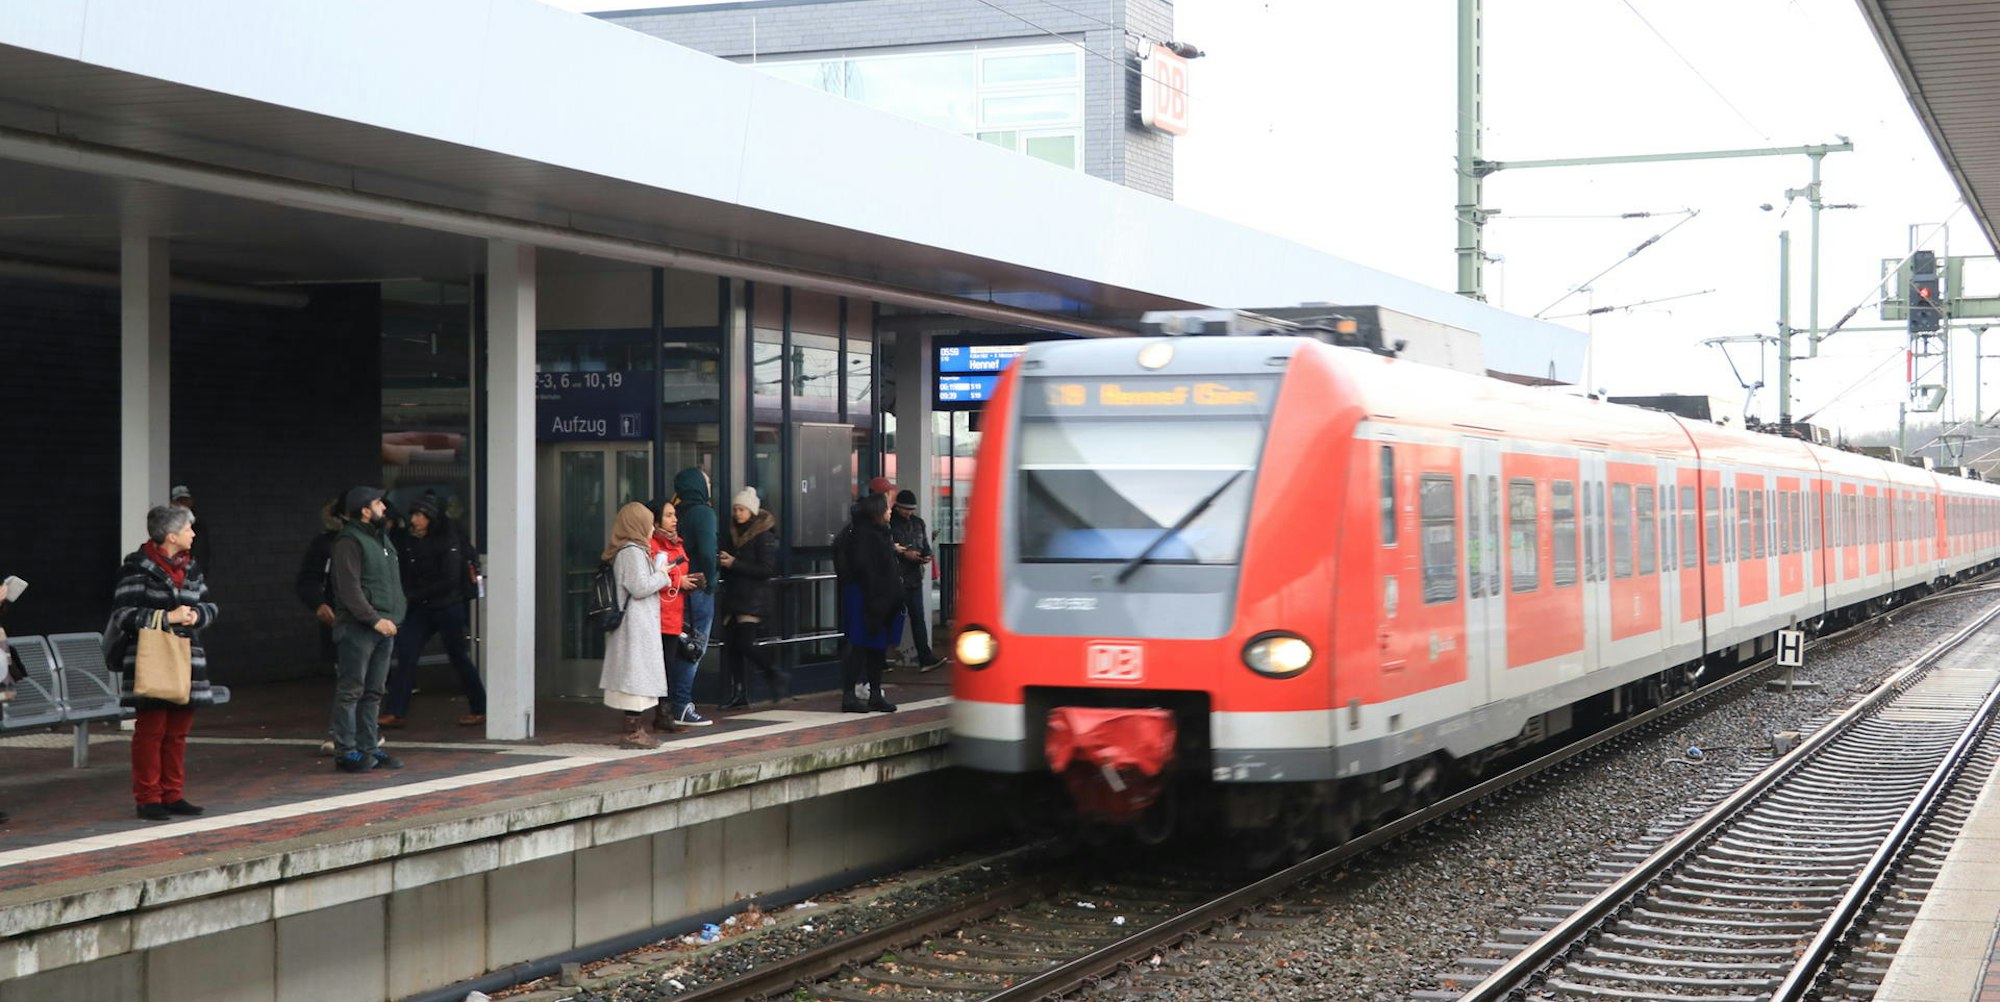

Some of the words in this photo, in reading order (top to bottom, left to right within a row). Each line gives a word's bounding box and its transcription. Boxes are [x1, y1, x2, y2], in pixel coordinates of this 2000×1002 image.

[1158, 60, 1185, 120] DB
[969, 359, 1000, 370] Hennef
[560, 373, 570, 388] 6
[552, 416, 607, 437] Aufzug
[1780, 634, 1800, 663] H
[1091, 648, 1139, 676] DB
